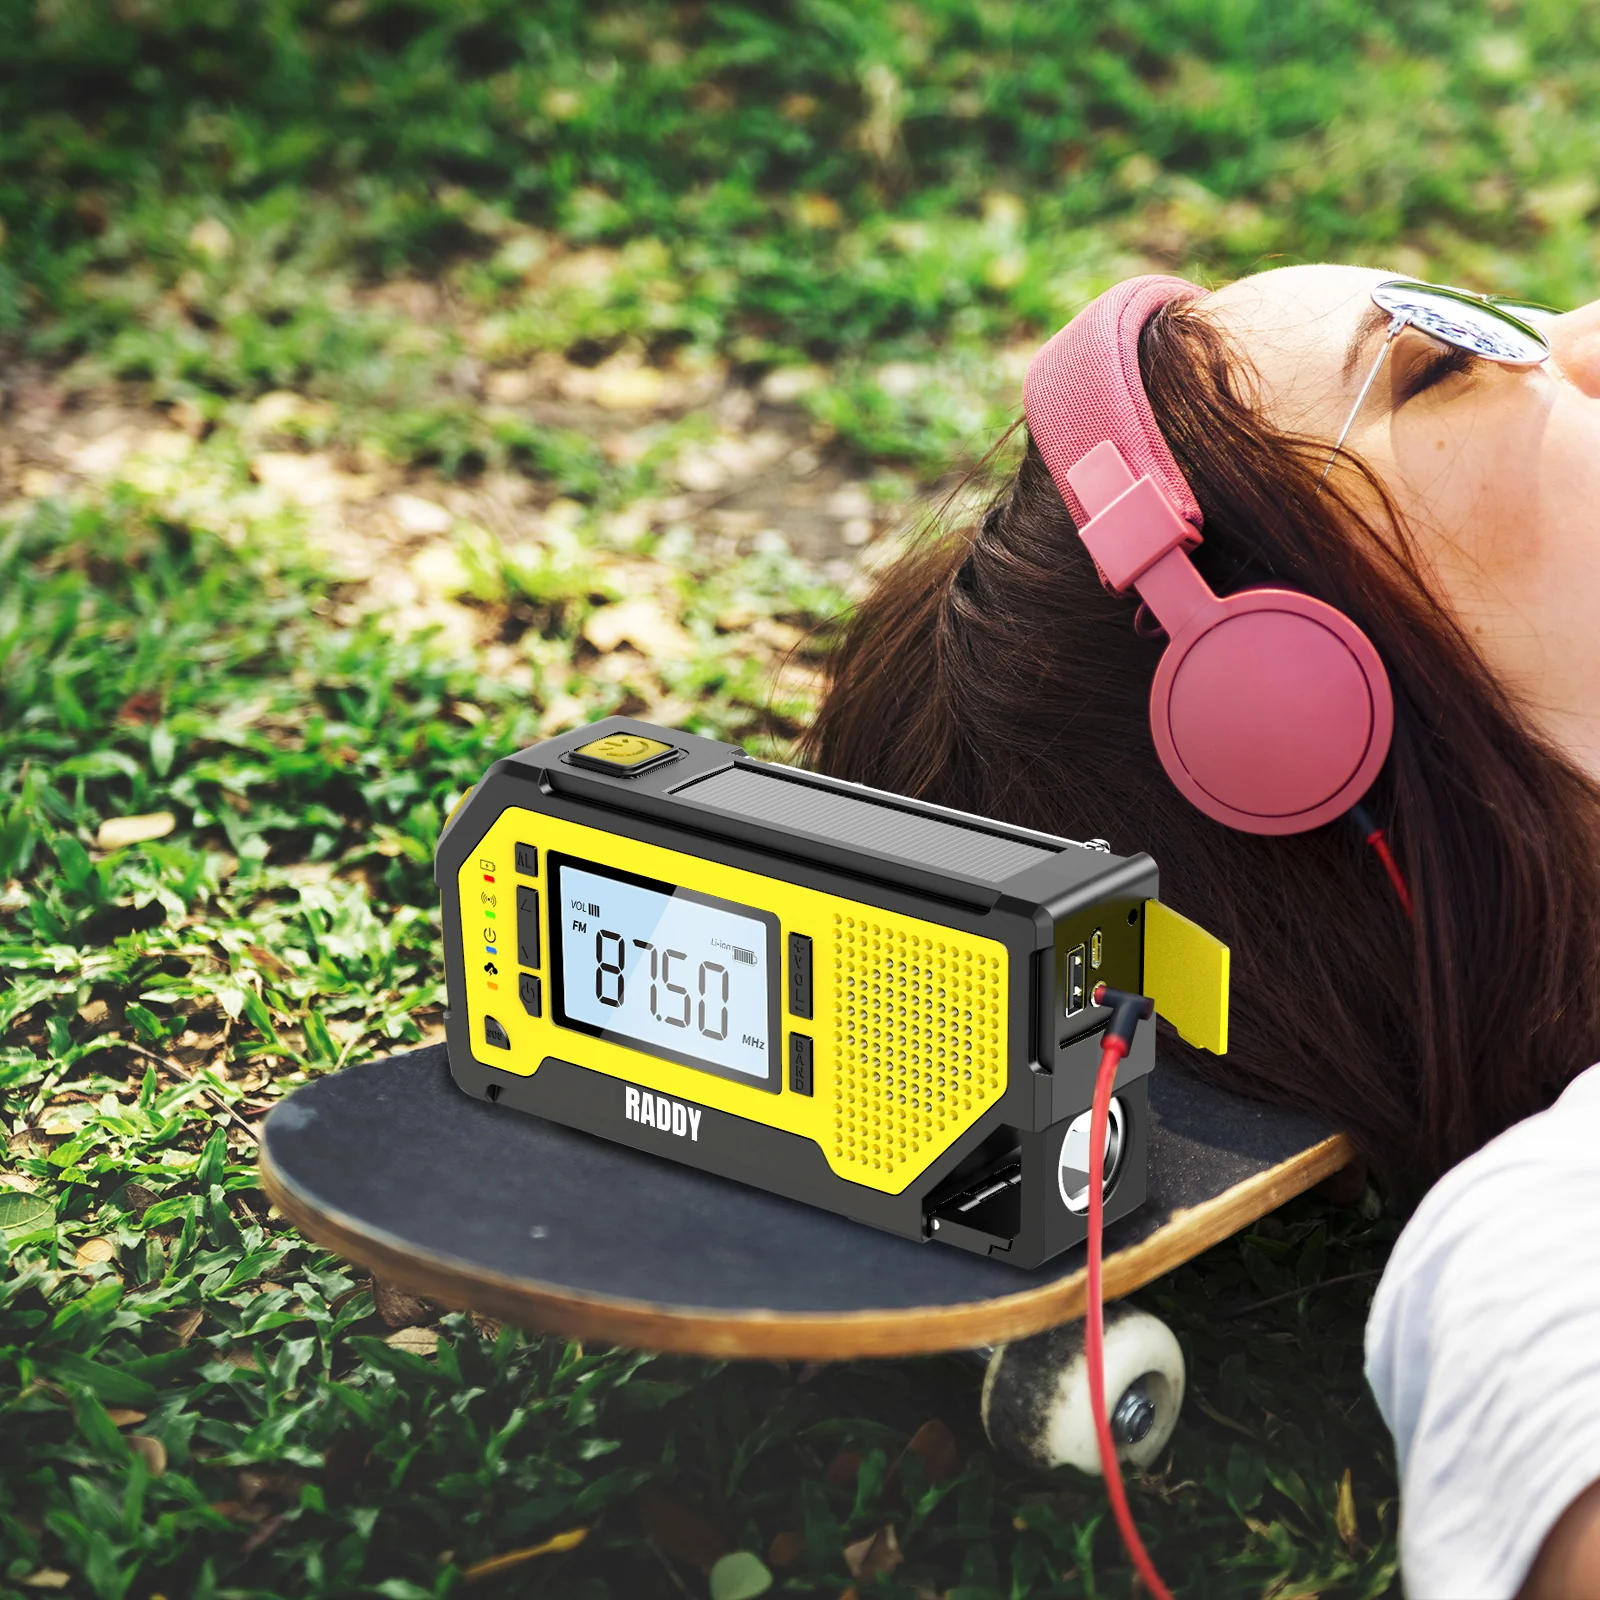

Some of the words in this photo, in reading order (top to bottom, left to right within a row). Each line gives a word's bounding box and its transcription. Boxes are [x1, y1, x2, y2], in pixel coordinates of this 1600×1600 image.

[517, 852, 532, 870] AL
[570, 899, 587, 913] VOL
[572, 919, 588, 934] FM
[710, 937, 731, 951] Li-ion
[595, 929, 729, 1041] 87.50
[742, 1033, 766, 1051] MHz
[795, 1040, 804, 1092] BAND
[625, 1085, 702, 1142] RADDY
